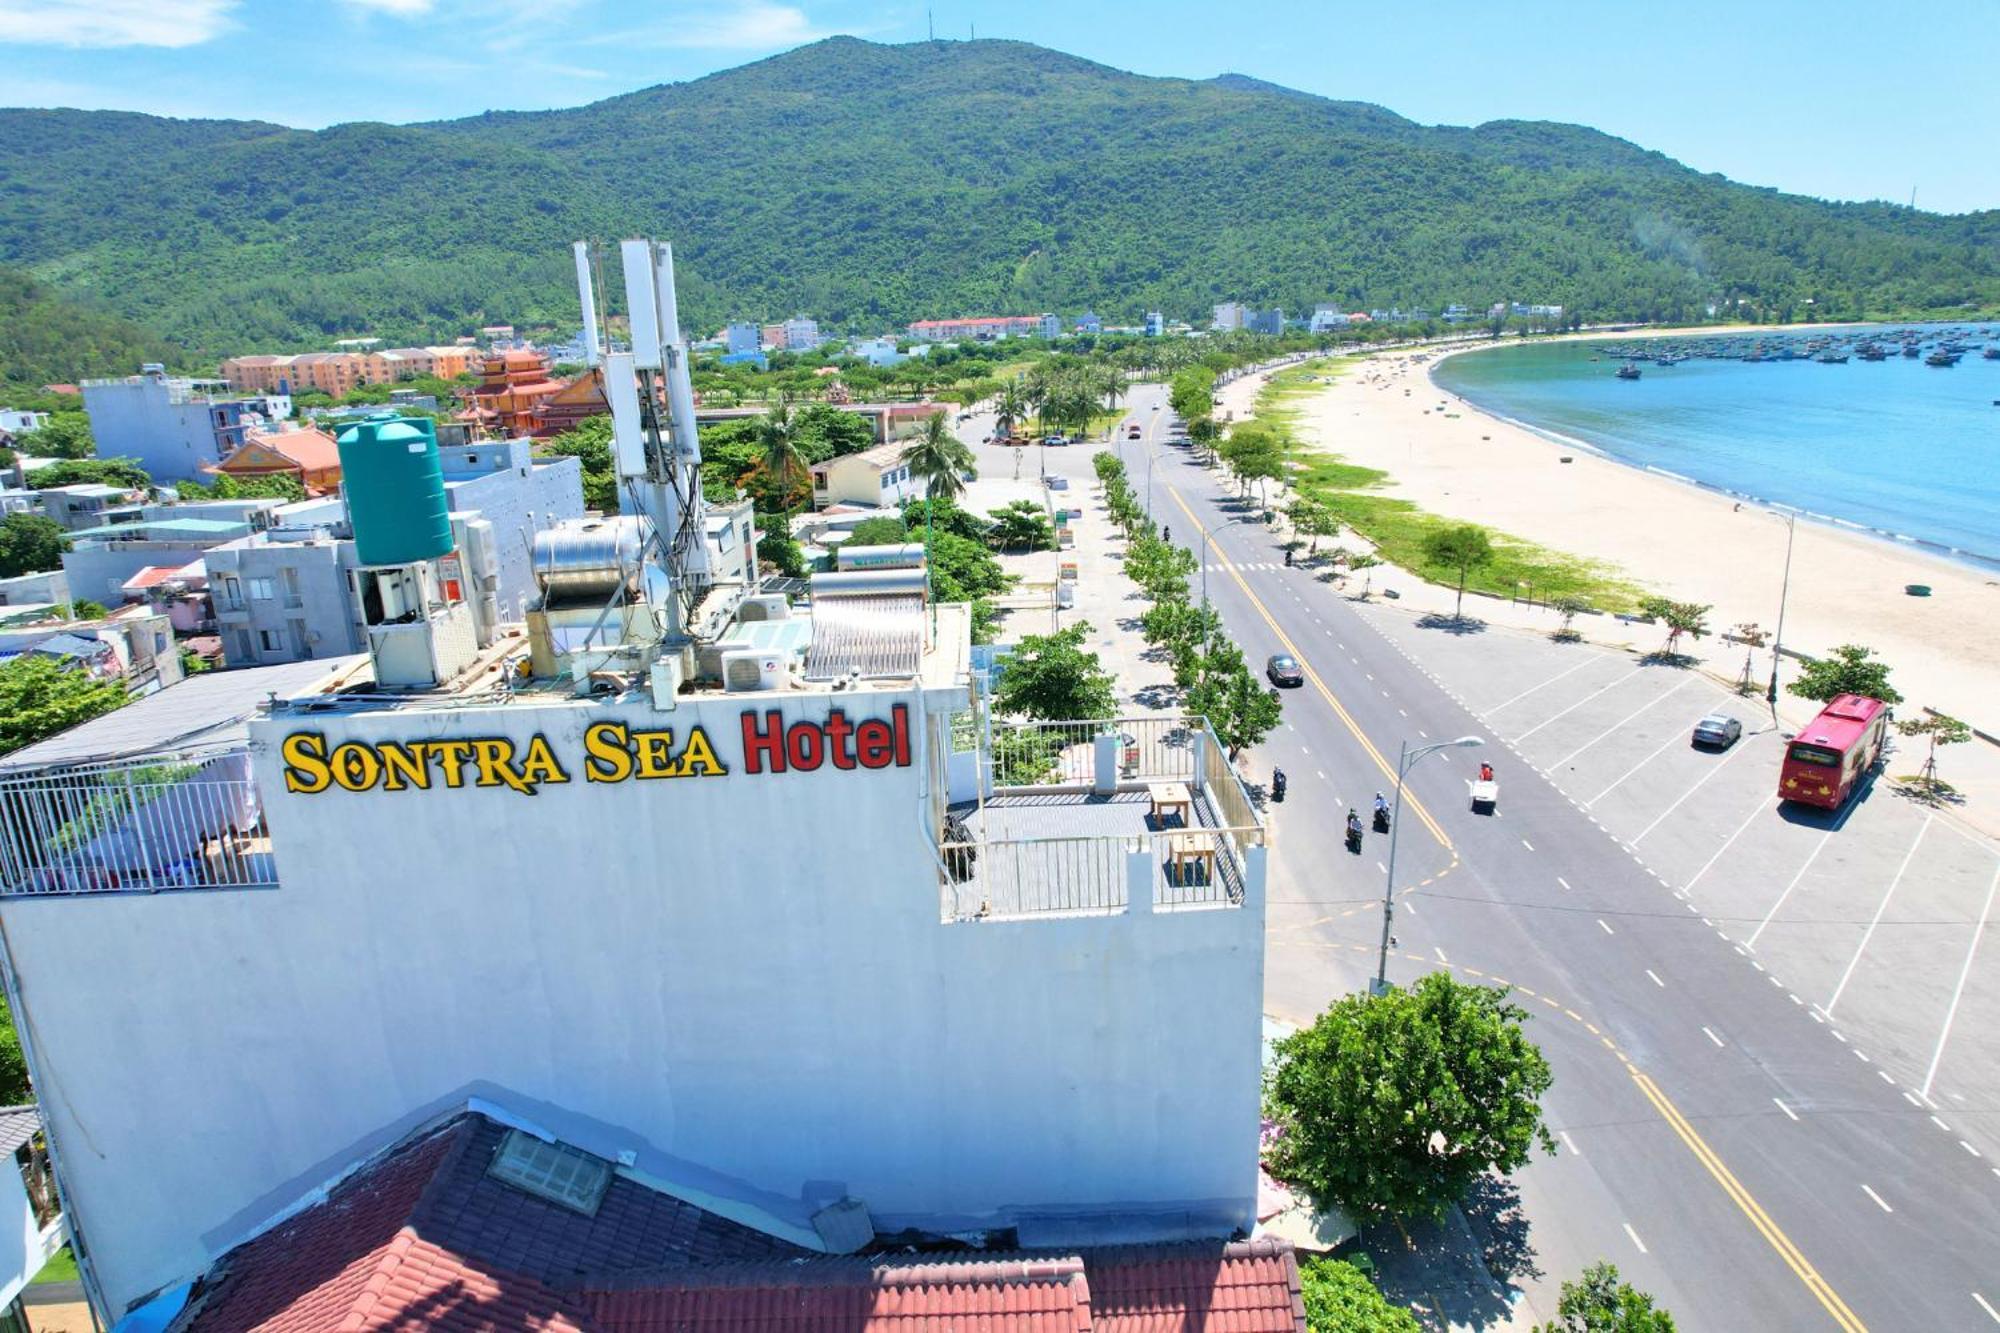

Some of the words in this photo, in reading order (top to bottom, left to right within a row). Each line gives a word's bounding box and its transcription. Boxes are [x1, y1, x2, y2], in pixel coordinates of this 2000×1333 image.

[282, 731, 571, 796] SONTRA
[583, 720, 729, 784] SEA
[740, 703, 912, 775] Hotel
